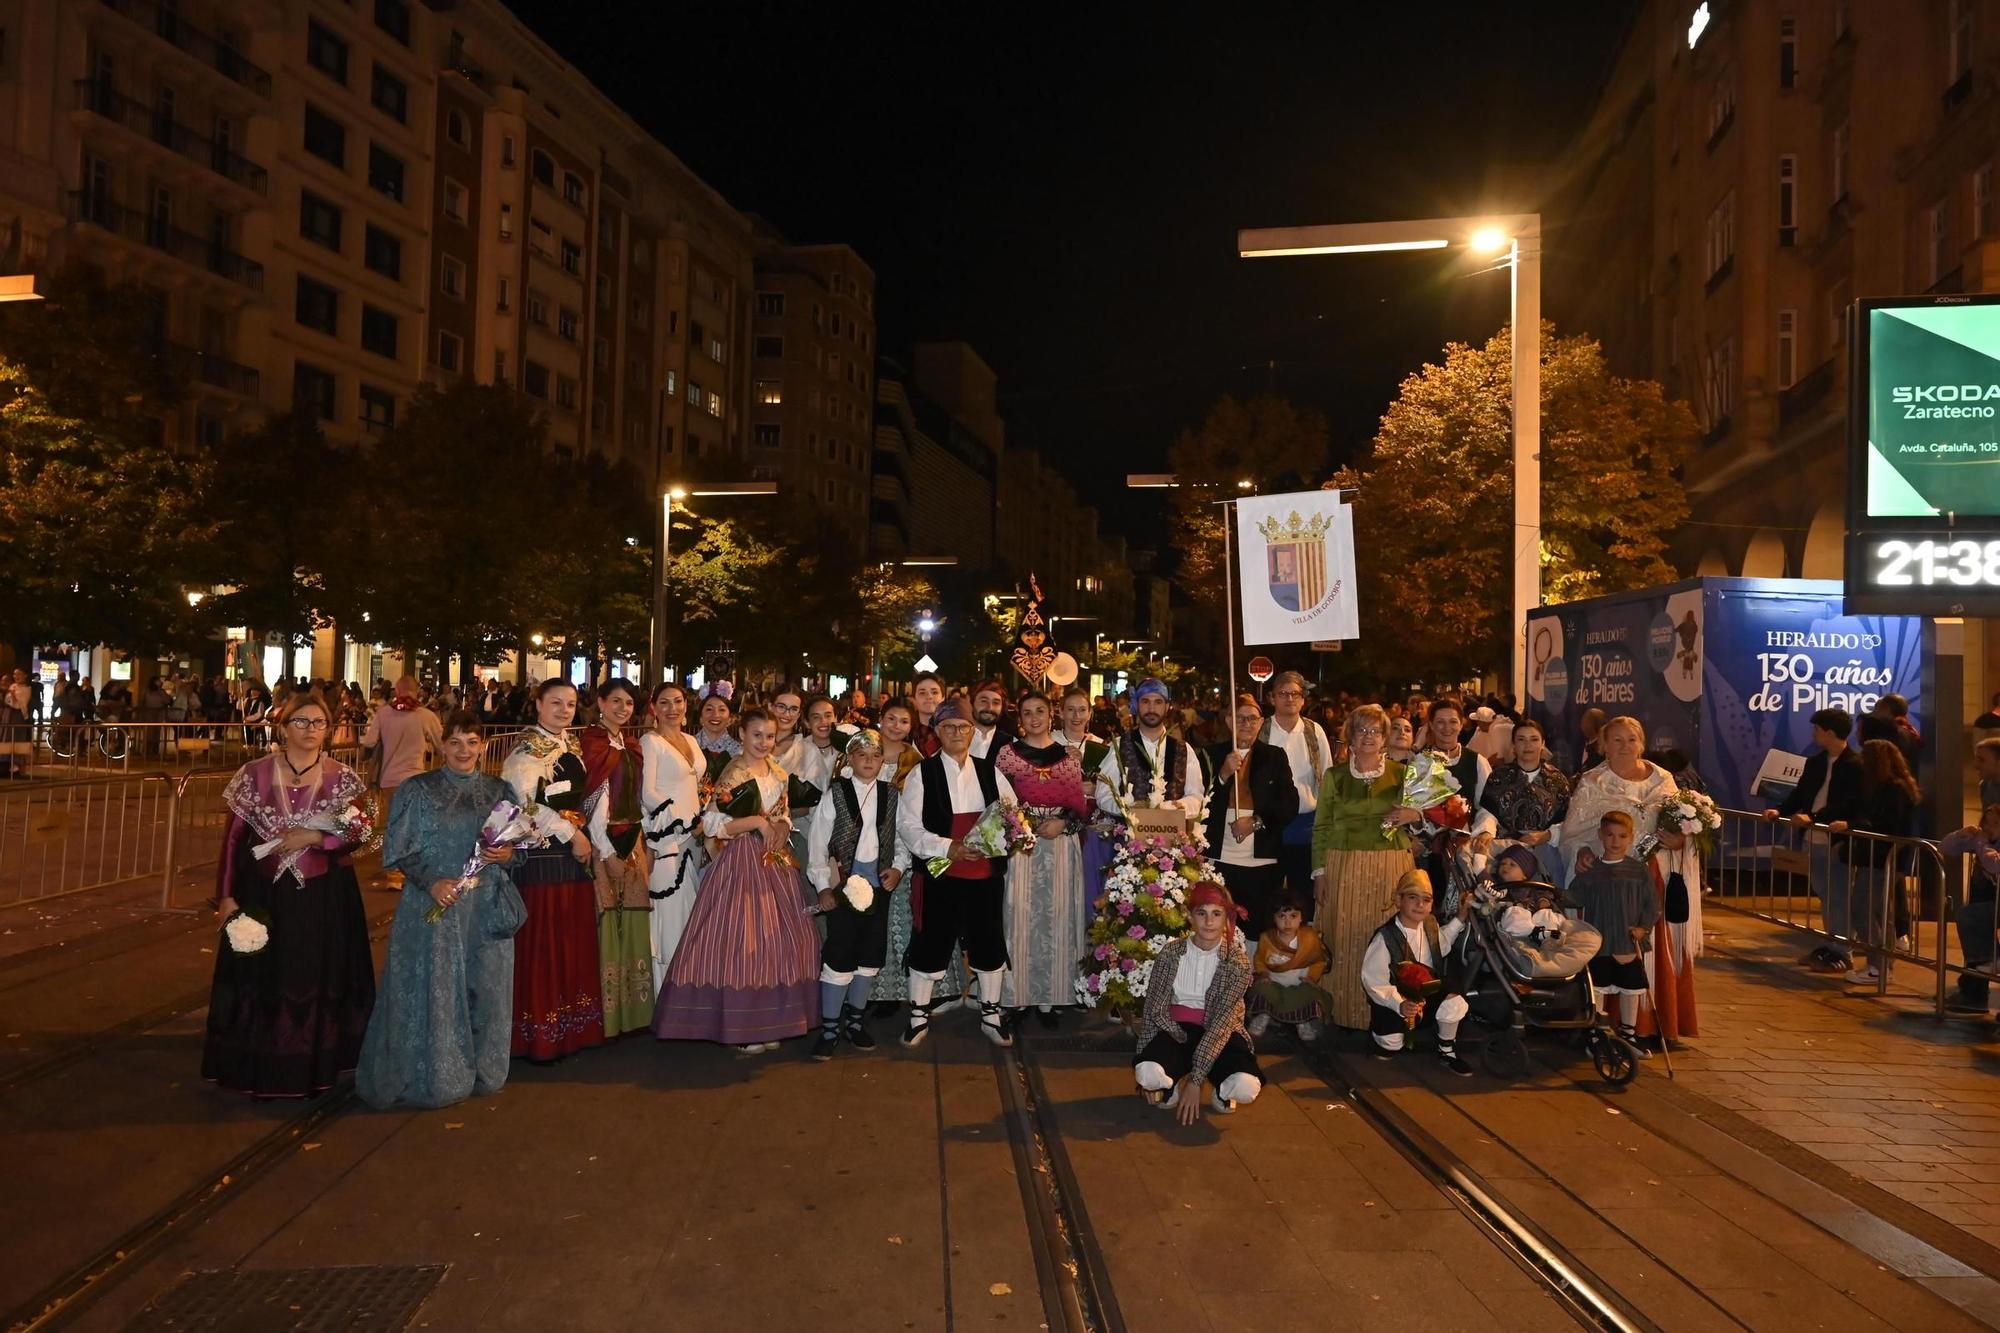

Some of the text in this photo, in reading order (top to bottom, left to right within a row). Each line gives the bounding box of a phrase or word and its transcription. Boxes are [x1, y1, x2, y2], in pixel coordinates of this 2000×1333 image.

[1903, 404, 1995, 419] Zaratecno
[1899, 442, 1999, 454] Avda. Cataluña, 105
[1877, 540, 2000, 585] 21:38
[1292, 614, 1313, 625] VILLA
[1312, 607, 1324, 617] DE
[1586, 630, 1620, 645] HERALDO
[1766, 630, 1859, 649] HERALDO
[1581, 654, 1633, 679] 130 años
[1757, 653, 1892, 686] 130 años
[1575, 676, 1635, 705] de Pilares
[1748, 683, 1883, 715] de Pilare
[1136, 824, 1178, 834] GODOJOS
